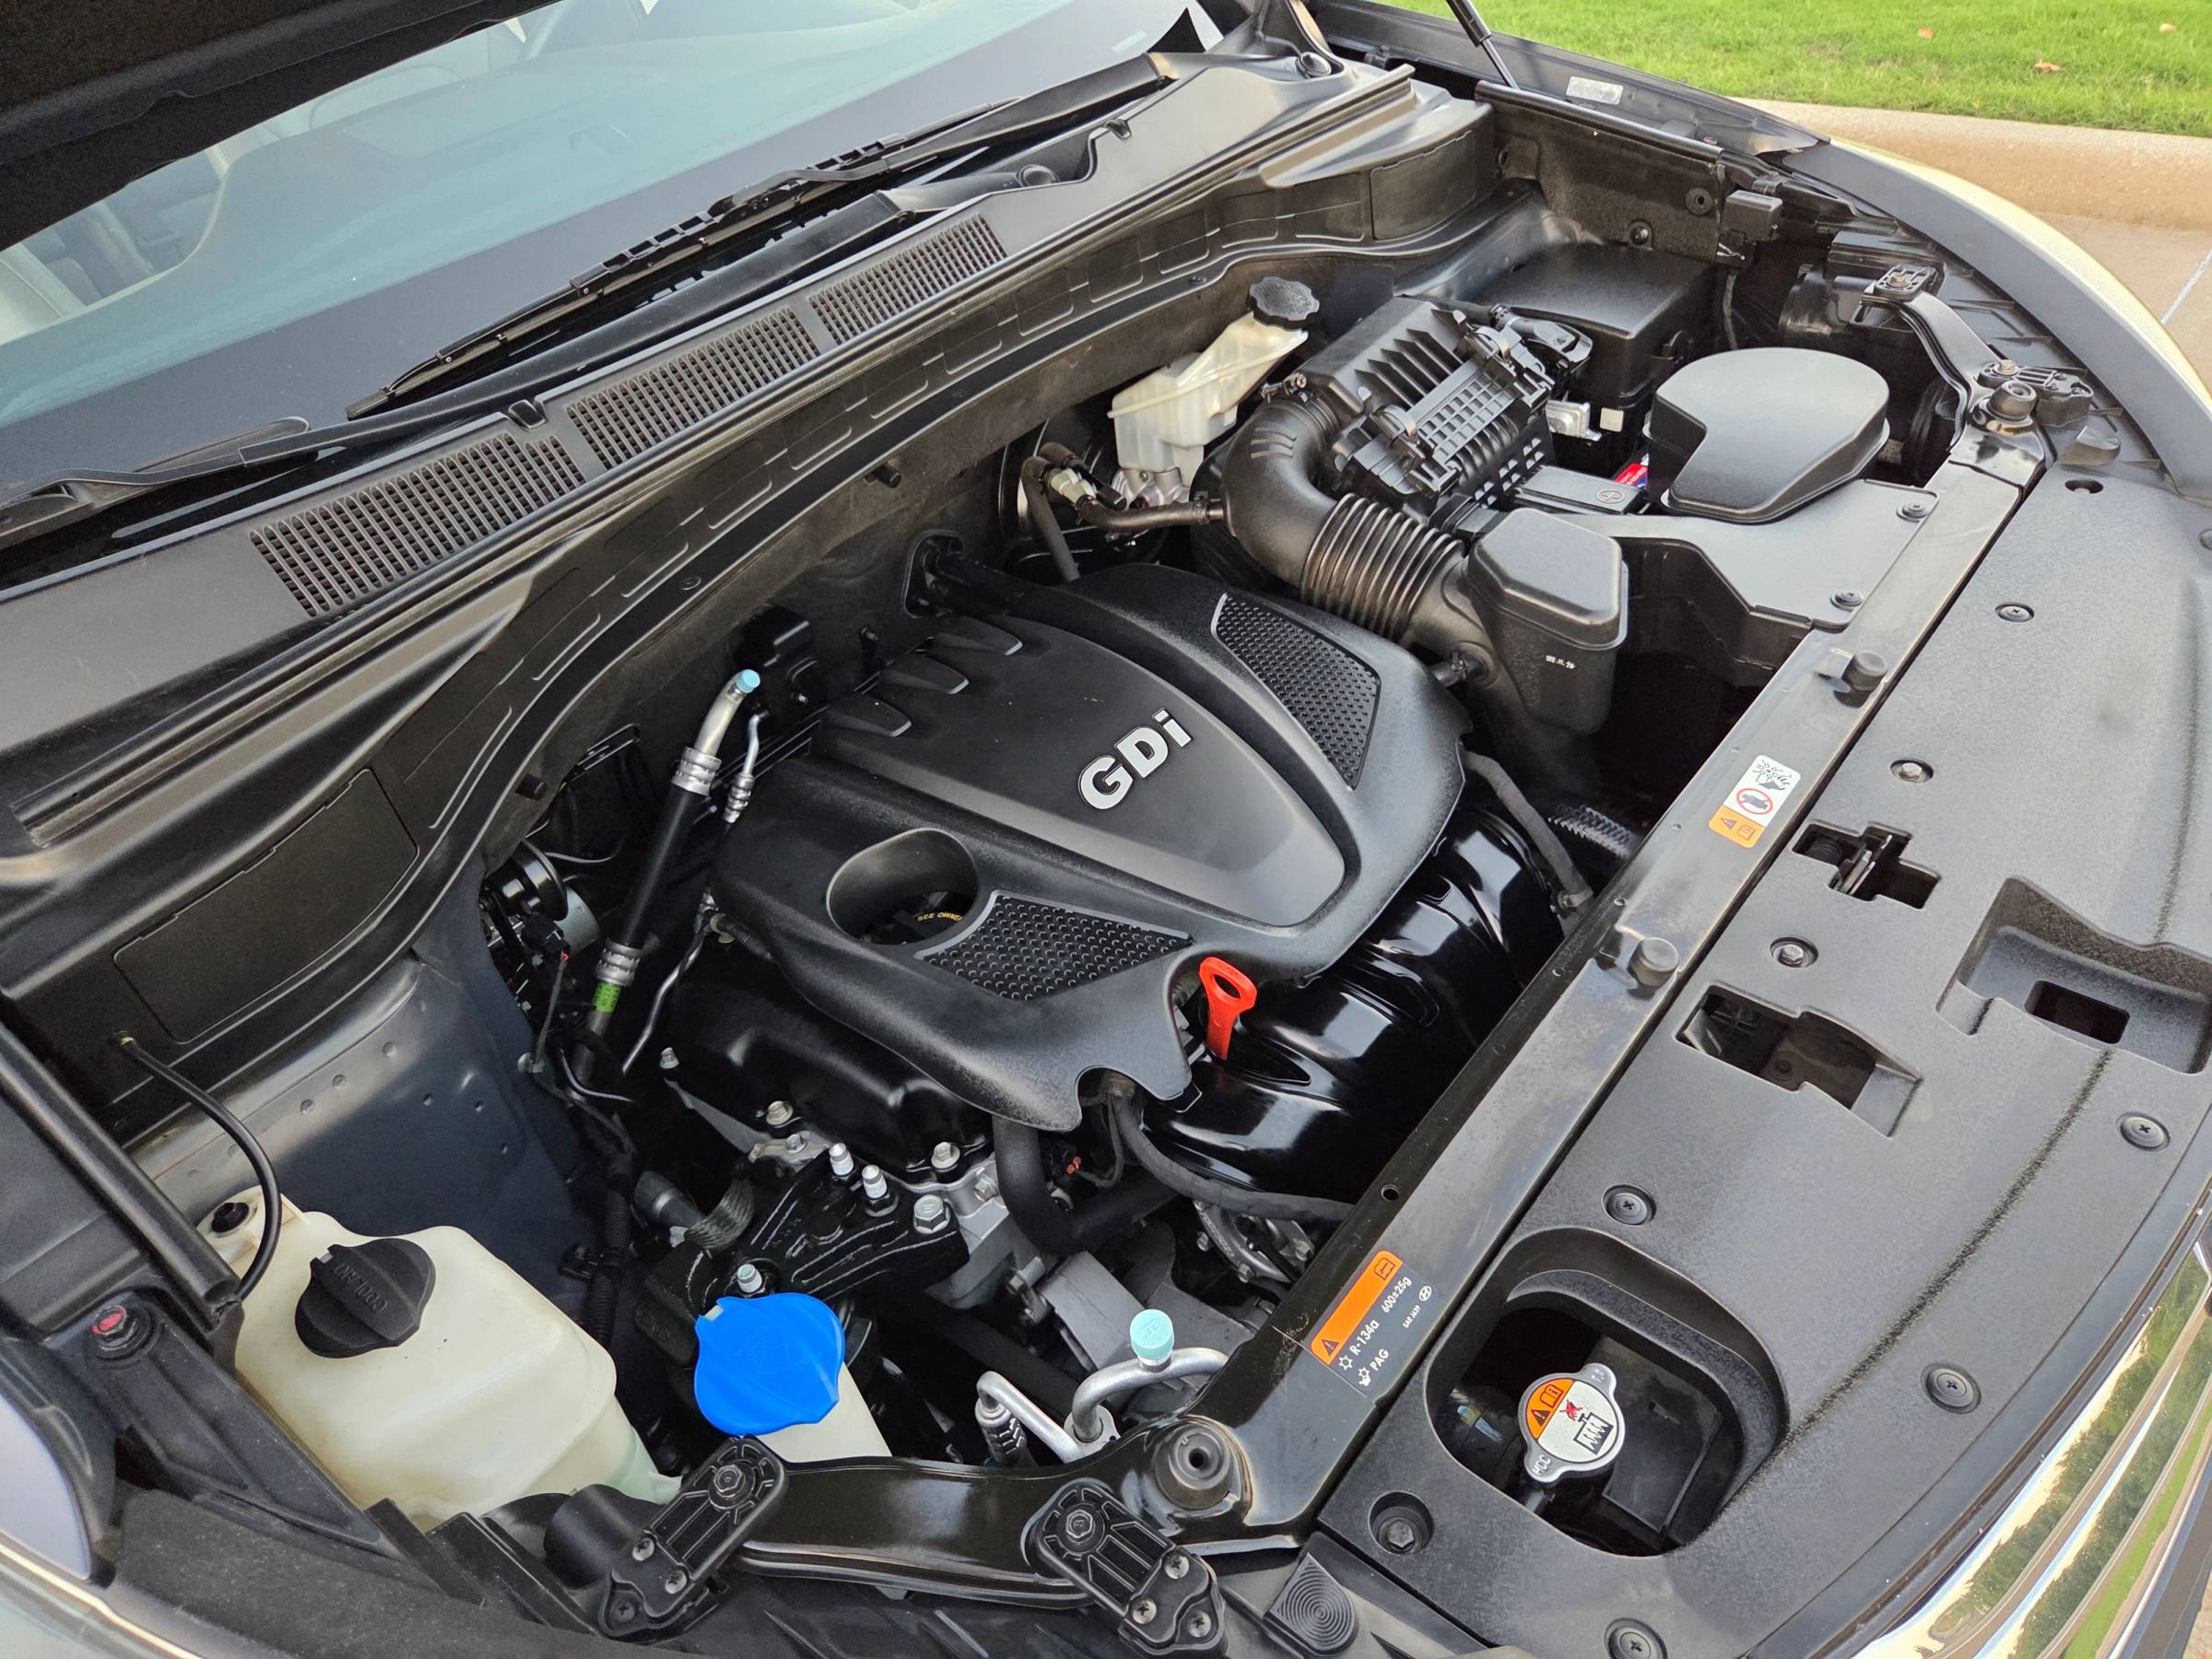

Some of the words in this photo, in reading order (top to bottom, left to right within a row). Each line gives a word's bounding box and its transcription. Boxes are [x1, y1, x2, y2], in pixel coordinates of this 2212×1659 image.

[1078, 708, 1194, 810] GDi
[917, 912, 935, 922] SEE
[332, 1263, 391, 1313] COOLANT
[1381, 1277, 1412, 1313] 600±25g
[1402, 1315, 1413, 1329] SAE
[1349, 1319, 1380, 1356] R-134a
[1370, 1348, 1389, 1371] PAG
[1532, 1454, 1552, 1476] HCC
